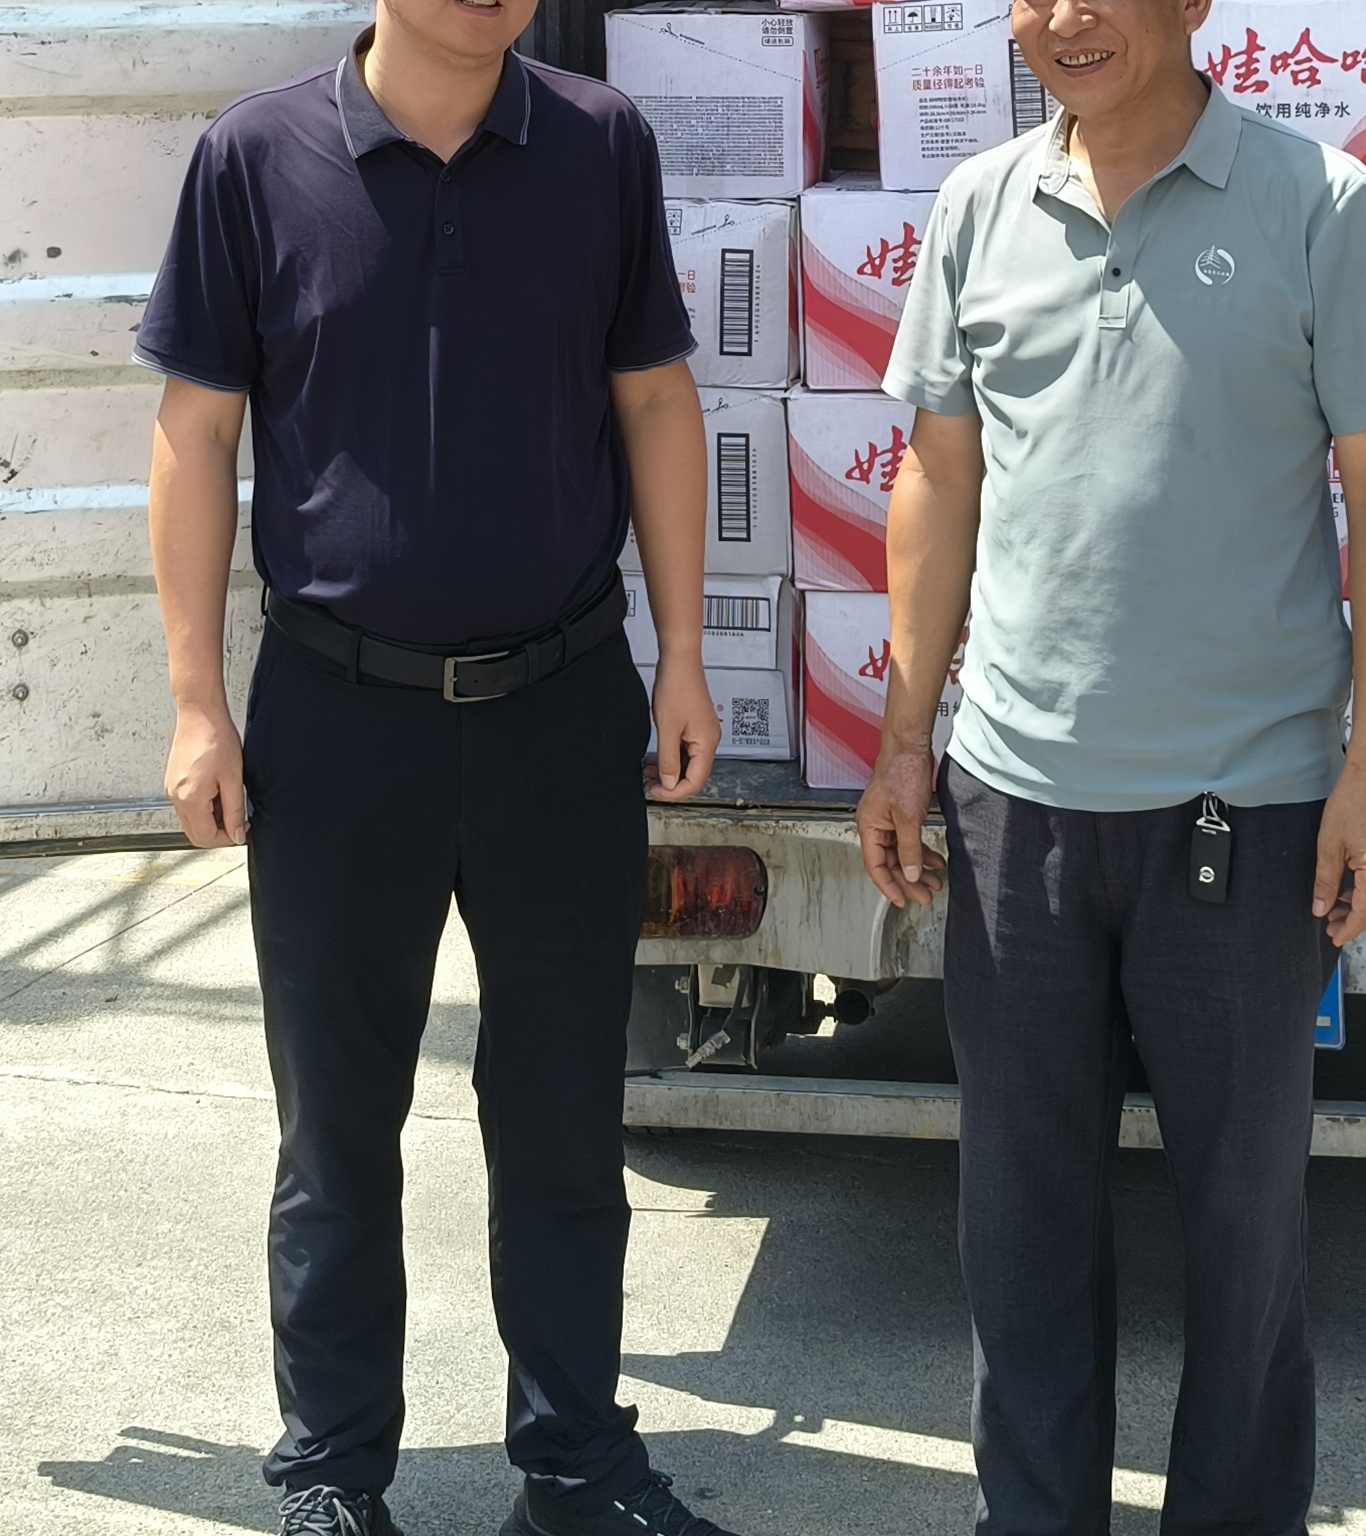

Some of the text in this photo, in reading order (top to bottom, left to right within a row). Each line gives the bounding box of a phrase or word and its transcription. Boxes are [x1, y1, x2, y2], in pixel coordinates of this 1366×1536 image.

[912, 64, 984, 77] 二十余年如一日
[1255, 102, 1351, 119] 饮用纯净水
